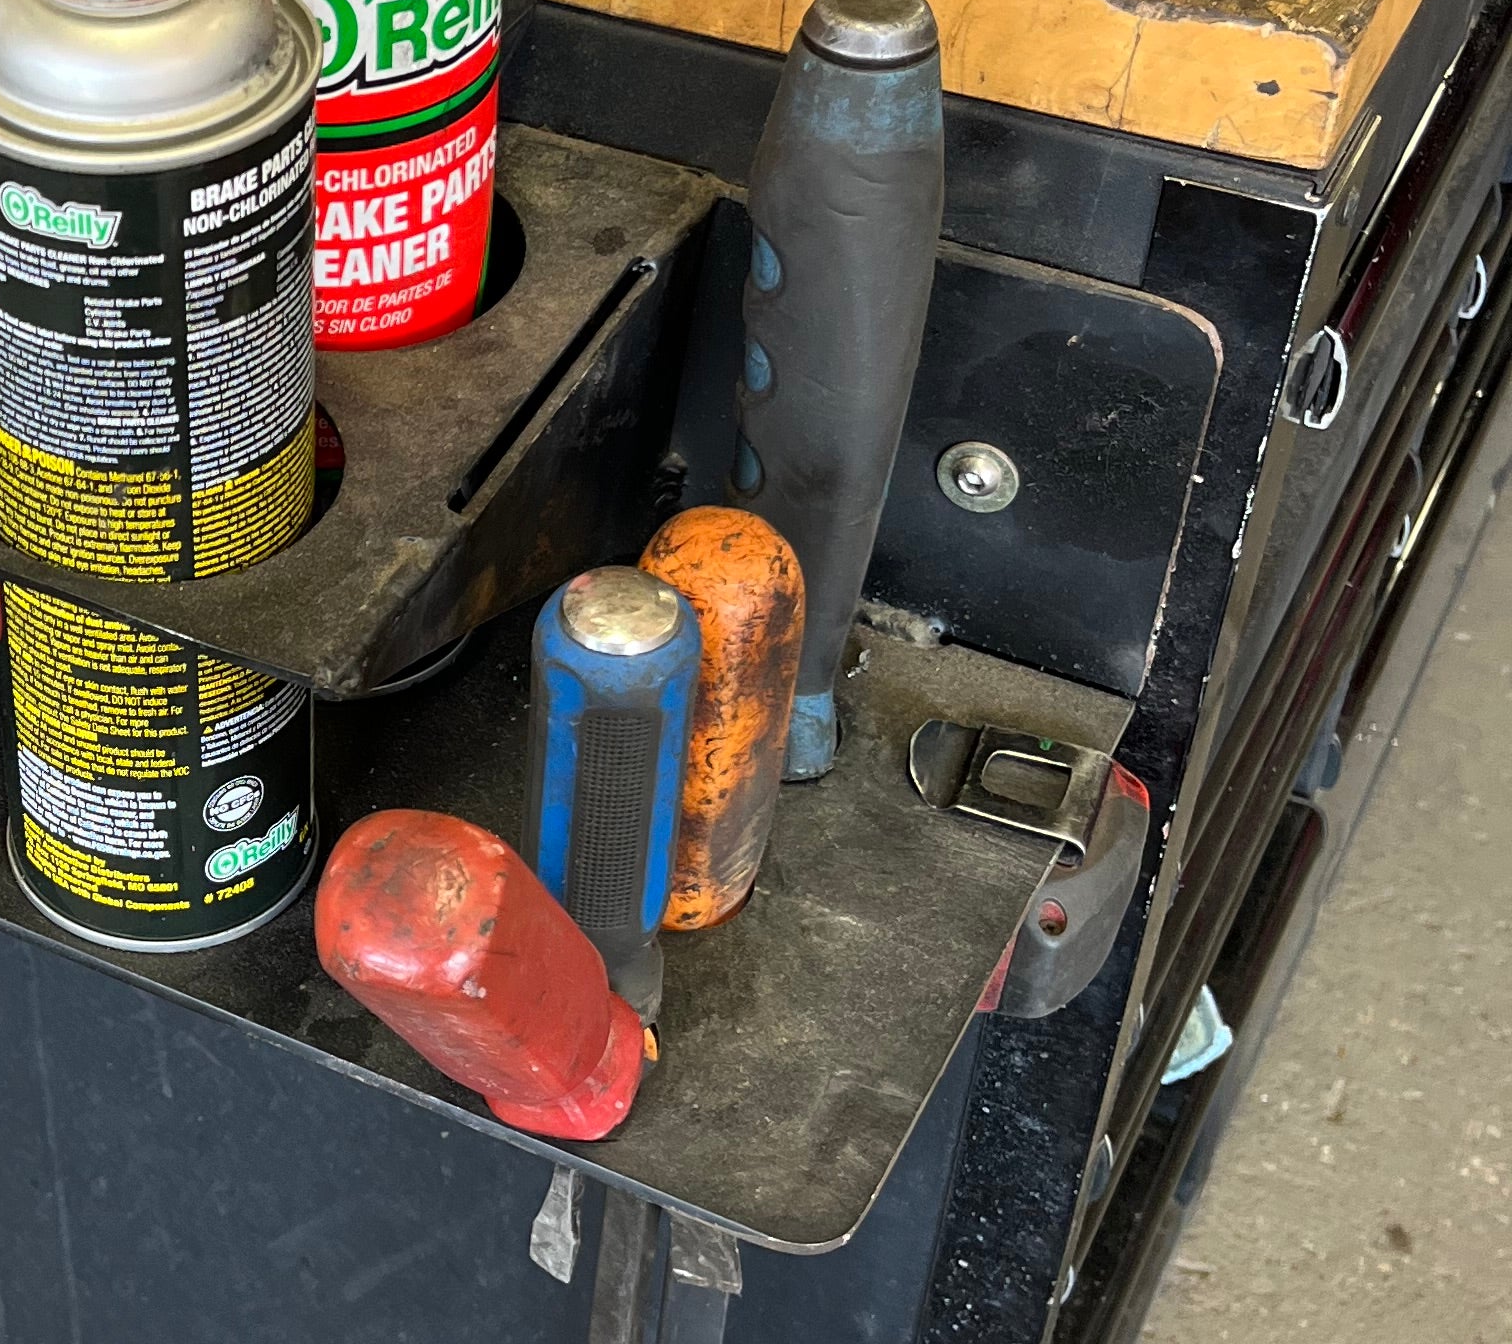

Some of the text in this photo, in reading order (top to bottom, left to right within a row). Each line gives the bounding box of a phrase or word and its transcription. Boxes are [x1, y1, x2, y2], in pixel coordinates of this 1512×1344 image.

[190, 131, 303, 213] BRAKE PARTS
[183, 147, 310, 238] NON-CHLORINATED
[1, 186, 115, 245] O'Reilly
[314, 223, 451, 289] EANER
[351, 295, 375, 314] DE
[377, 281, 433, 309] PARTES
[434, 269, 452, 293] DE
[327, 307, 412, 334] SIN CLORO
[32, 447, 75, 476] POISON
[124, 694, 141, 706] NOT
[208, 808, 300, 880] O'Reilly
[90, 865, 151, 883] Distributors
[127, 882, 146, 892] MO
[215, 877, 255, 901] 72408
[125, 900, 191, 912] Components
